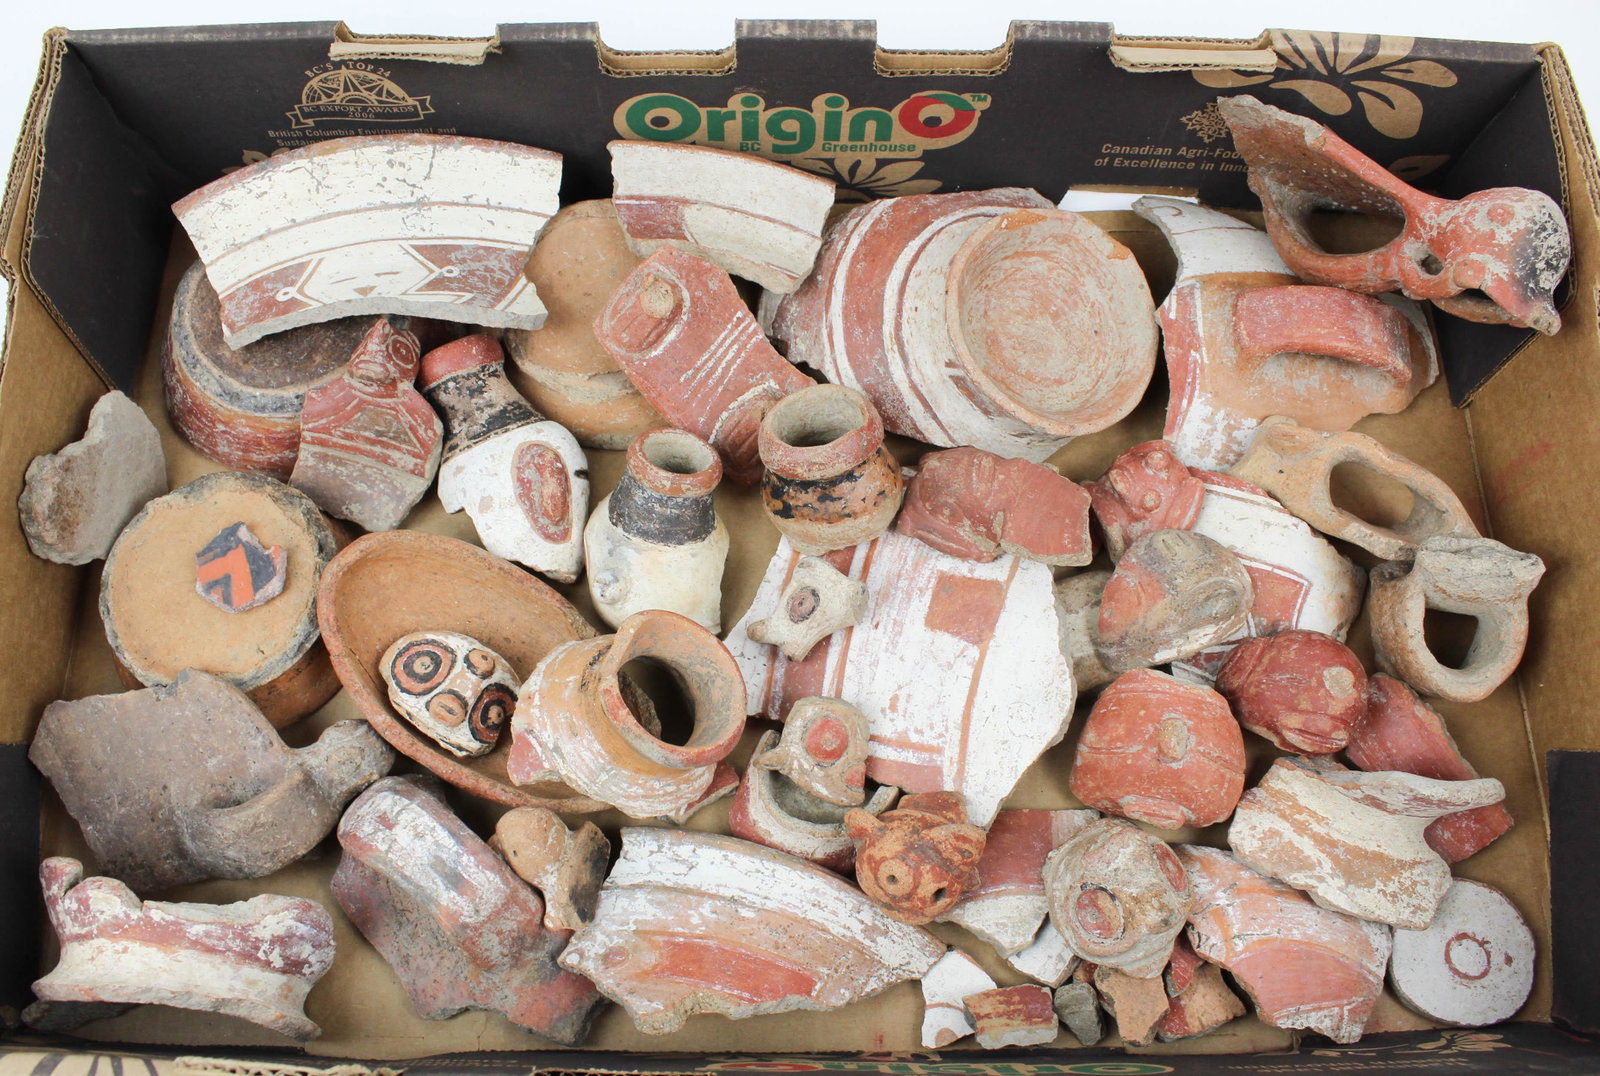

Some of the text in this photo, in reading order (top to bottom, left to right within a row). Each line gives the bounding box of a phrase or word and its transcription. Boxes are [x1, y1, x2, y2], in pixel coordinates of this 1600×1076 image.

[304, 61, 391, 78] BC'S TOP 24
[303, 105, 415, 113] BC EXPORT AWARDS
[348, 111, 375, 119] 2006
[267, 130, 303, 139] British
[306, 128, 355, 138] Columbia
[437, 127, 457, 135] and
[739, 142, 761, 152] BC
[821, 142, 917, 153] Greenhouse
[1101, 143, 1244, 160] Canadian Agri-Foo
[1094, 156, 1109, 167] of
[1112, 157, 1196, 170] Excellence
[1200, 160, 1215, 171] in
